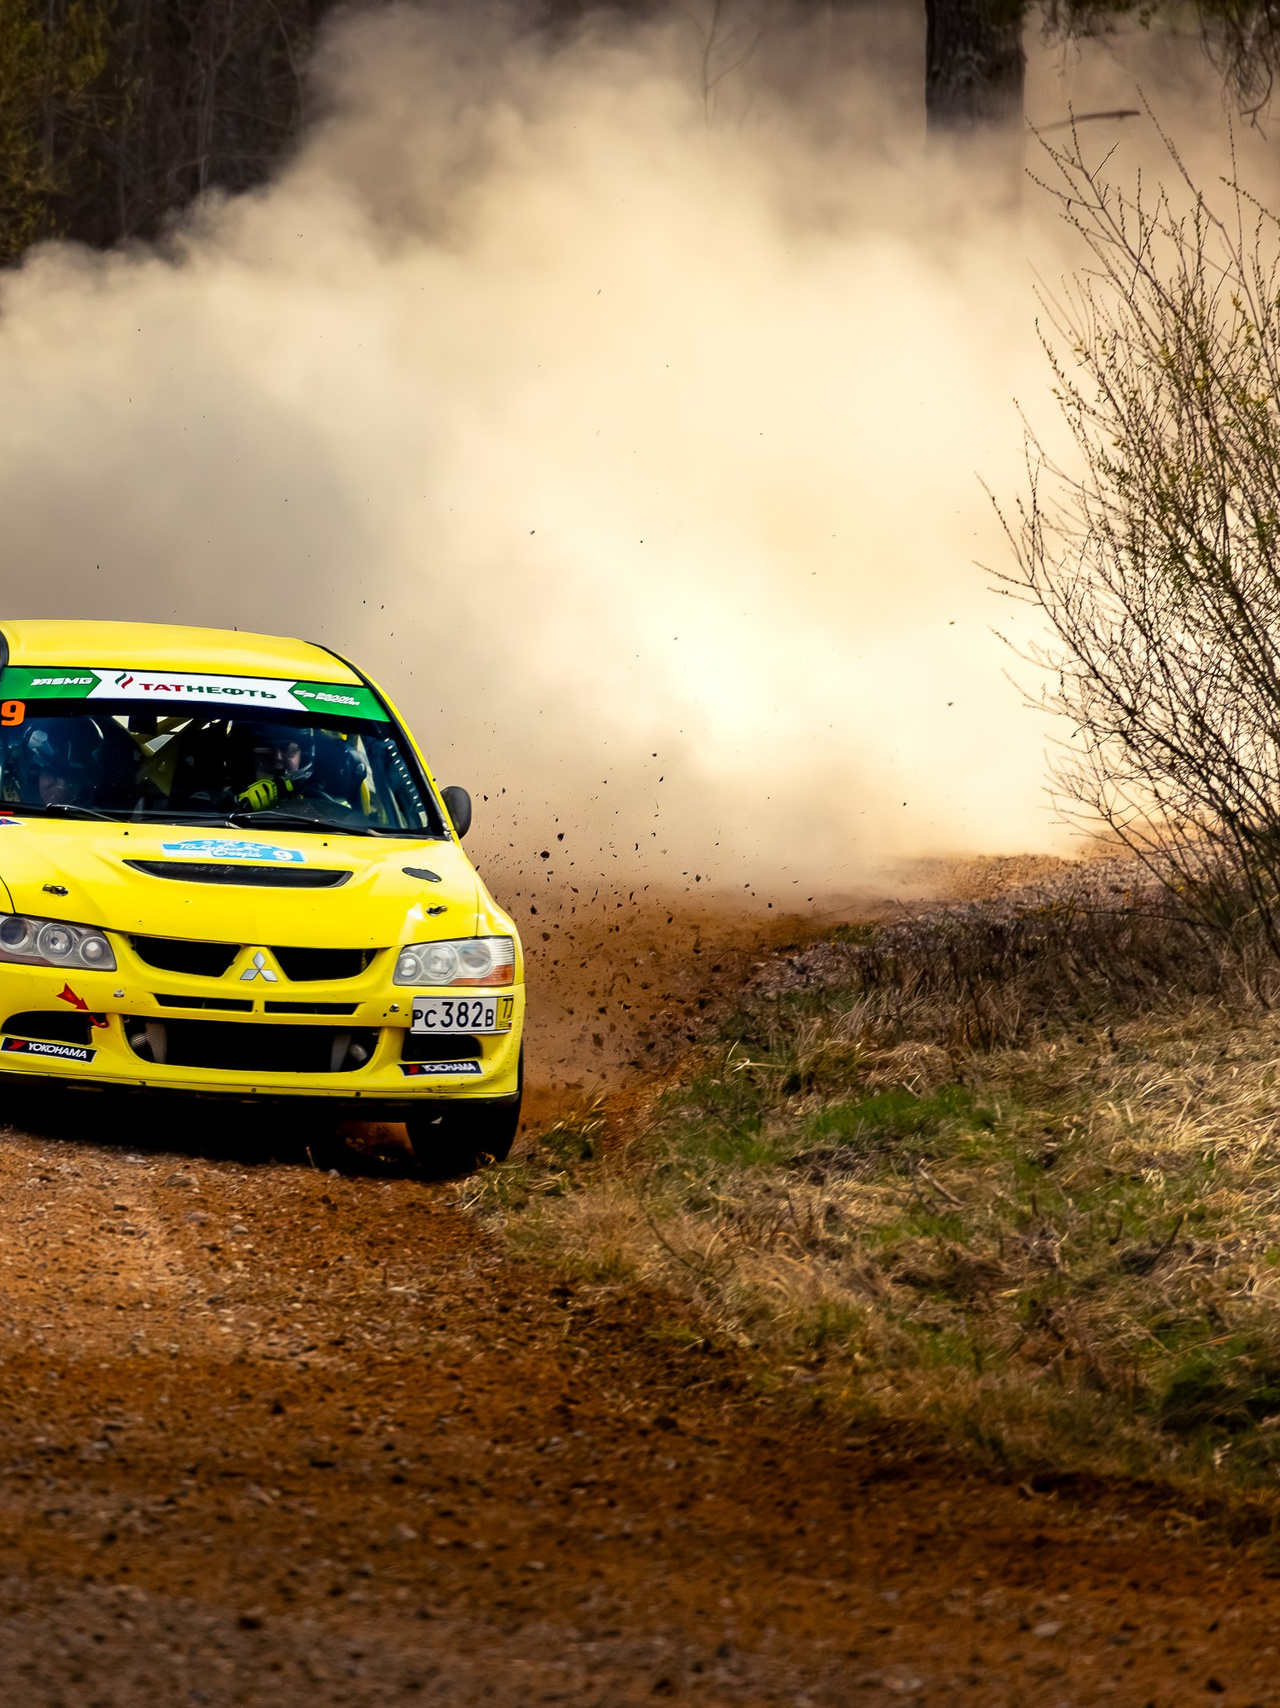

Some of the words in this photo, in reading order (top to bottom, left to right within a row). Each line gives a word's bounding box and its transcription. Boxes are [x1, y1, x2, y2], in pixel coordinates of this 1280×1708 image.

[139, 683, 277, 699] ТАТНЕФТЬ
[1, 700, 26, 726] 9
[272, 850, 294, 861] 9
[28, 1042, 87, 1059] YOKOHAMA
[422, 1062, 477, 1072] YOKOHAMA
